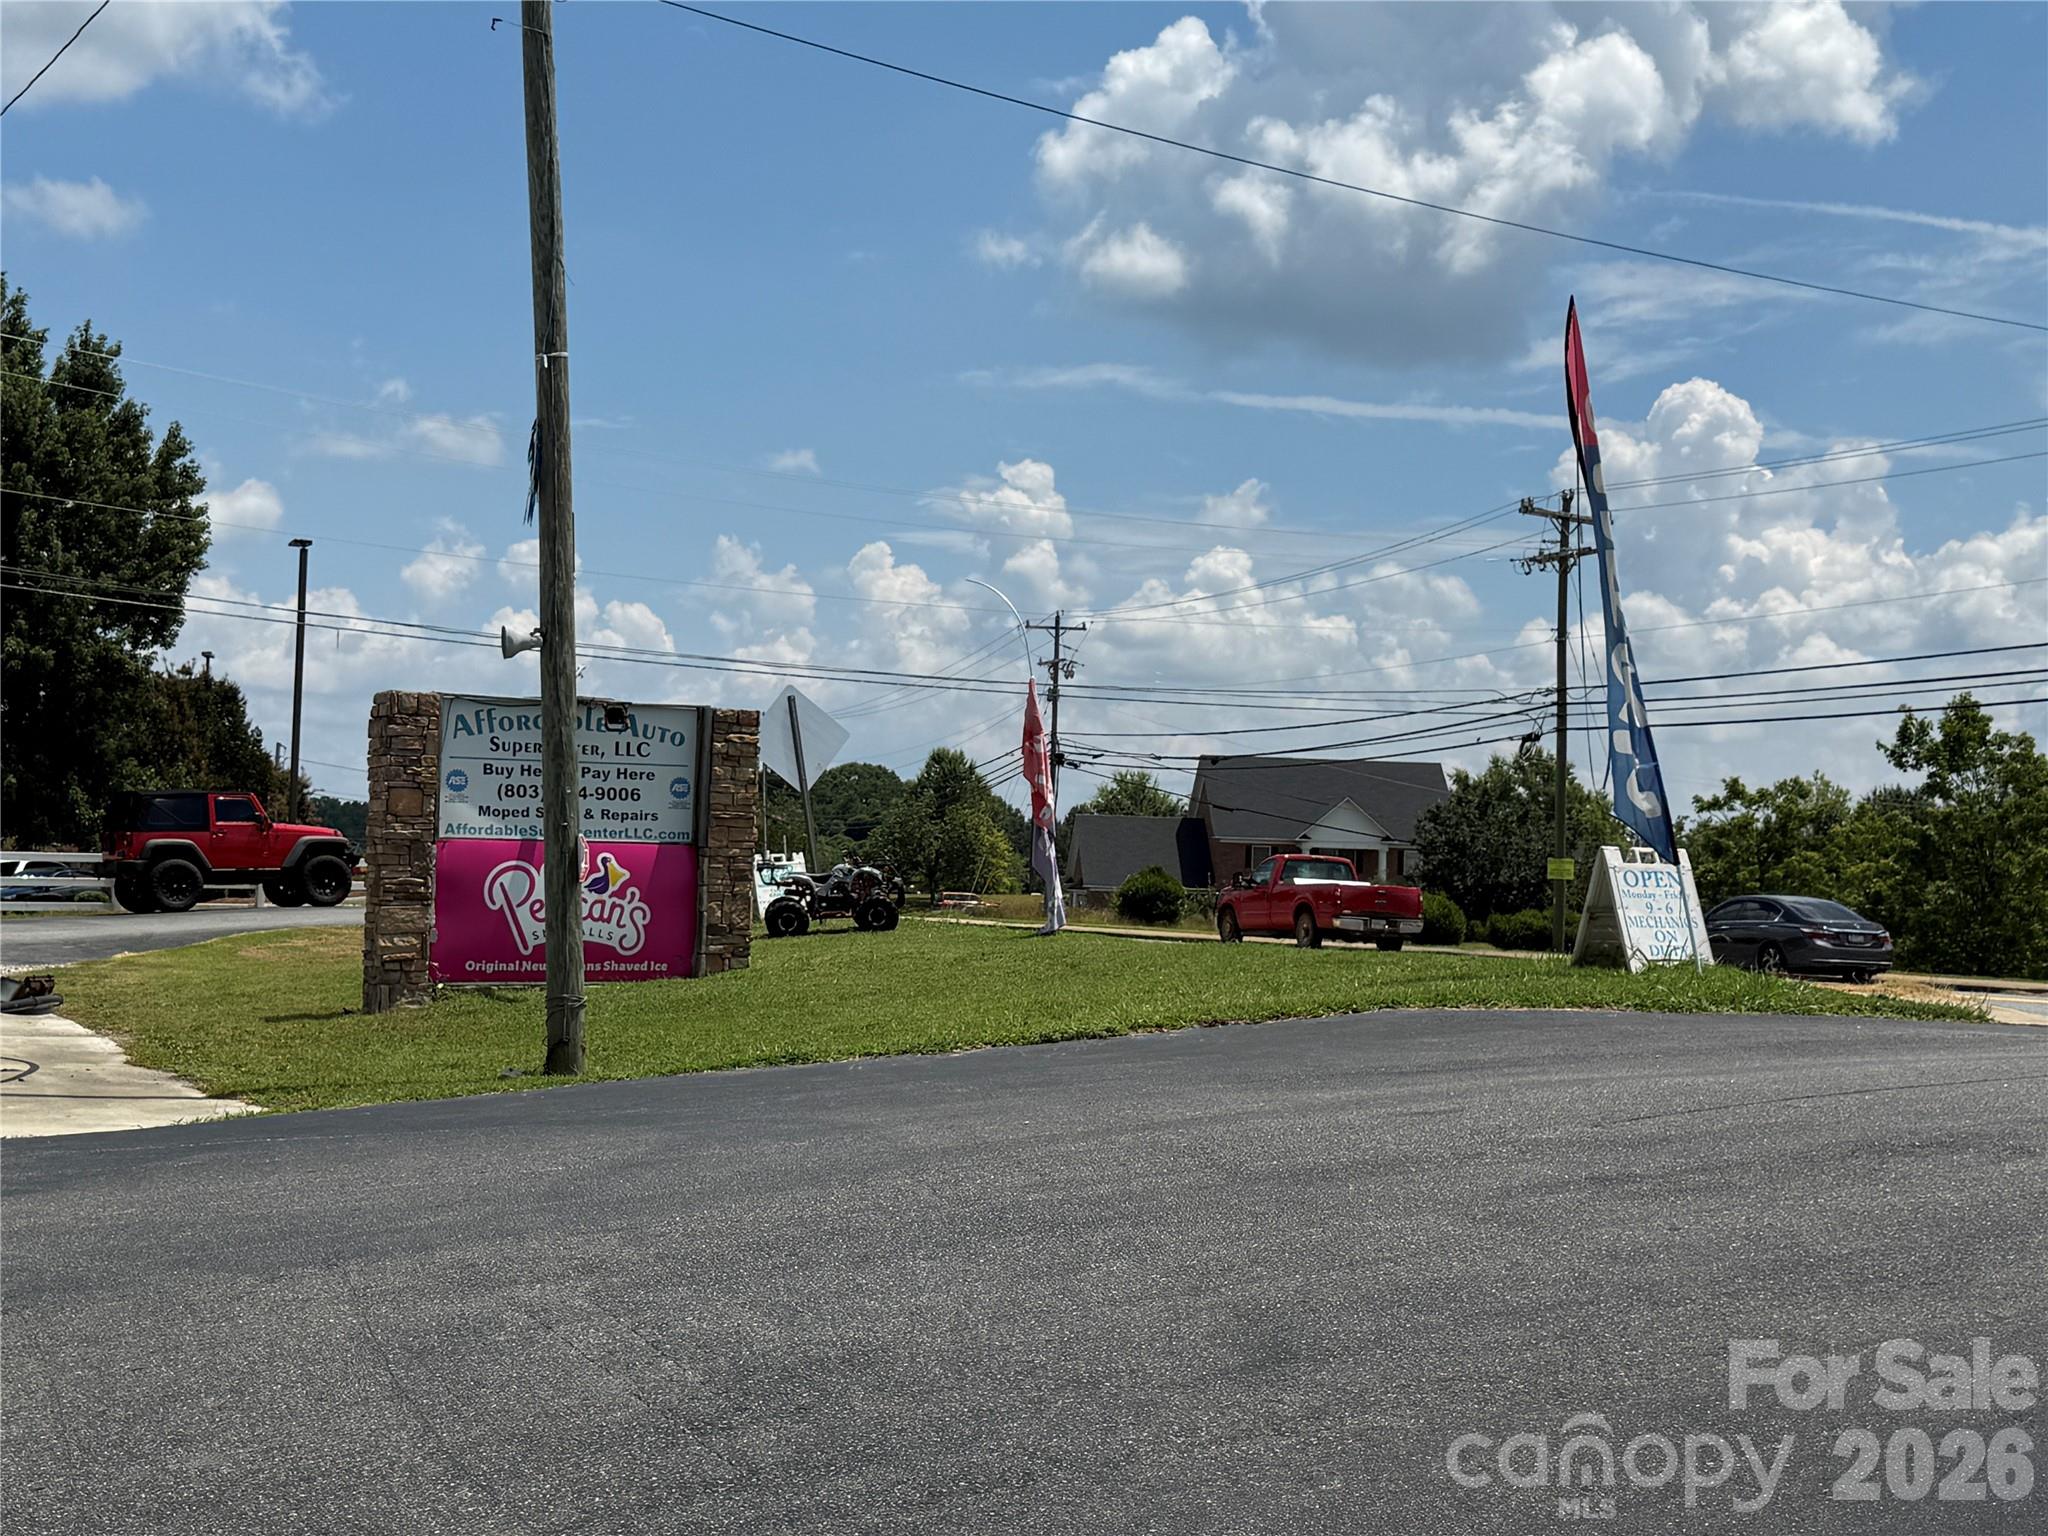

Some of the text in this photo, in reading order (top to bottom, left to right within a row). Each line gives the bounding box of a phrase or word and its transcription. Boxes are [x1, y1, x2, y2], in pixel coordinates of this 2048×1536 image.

[614, 741, 651, 758] LLC
[483, 763, 514, 779] Buy
[581, 766, 611, 782] Pay
[617, 768, 656, 781] Here
[578, 786, 641, 801] 4-9006
[478, 805, 530, 820] Moped
[584, 808, 594, 820] &
[601, 809, 659, 823] Repairs
[1623, 870, 1683, 888] OPEN
[1622, 889, 1656, 900] Monday
[1645, 902, 1653, 914] 9
[1665, 902, 1673, 914] 6
[1627, 915, 1699, 929] MECHANICS
[1655, 930, 1678, 943] ON
[465, 960, 519, 973] Original
[603, 960, 648, 972] Shaved
[651, 961, 668, 972] Ice
